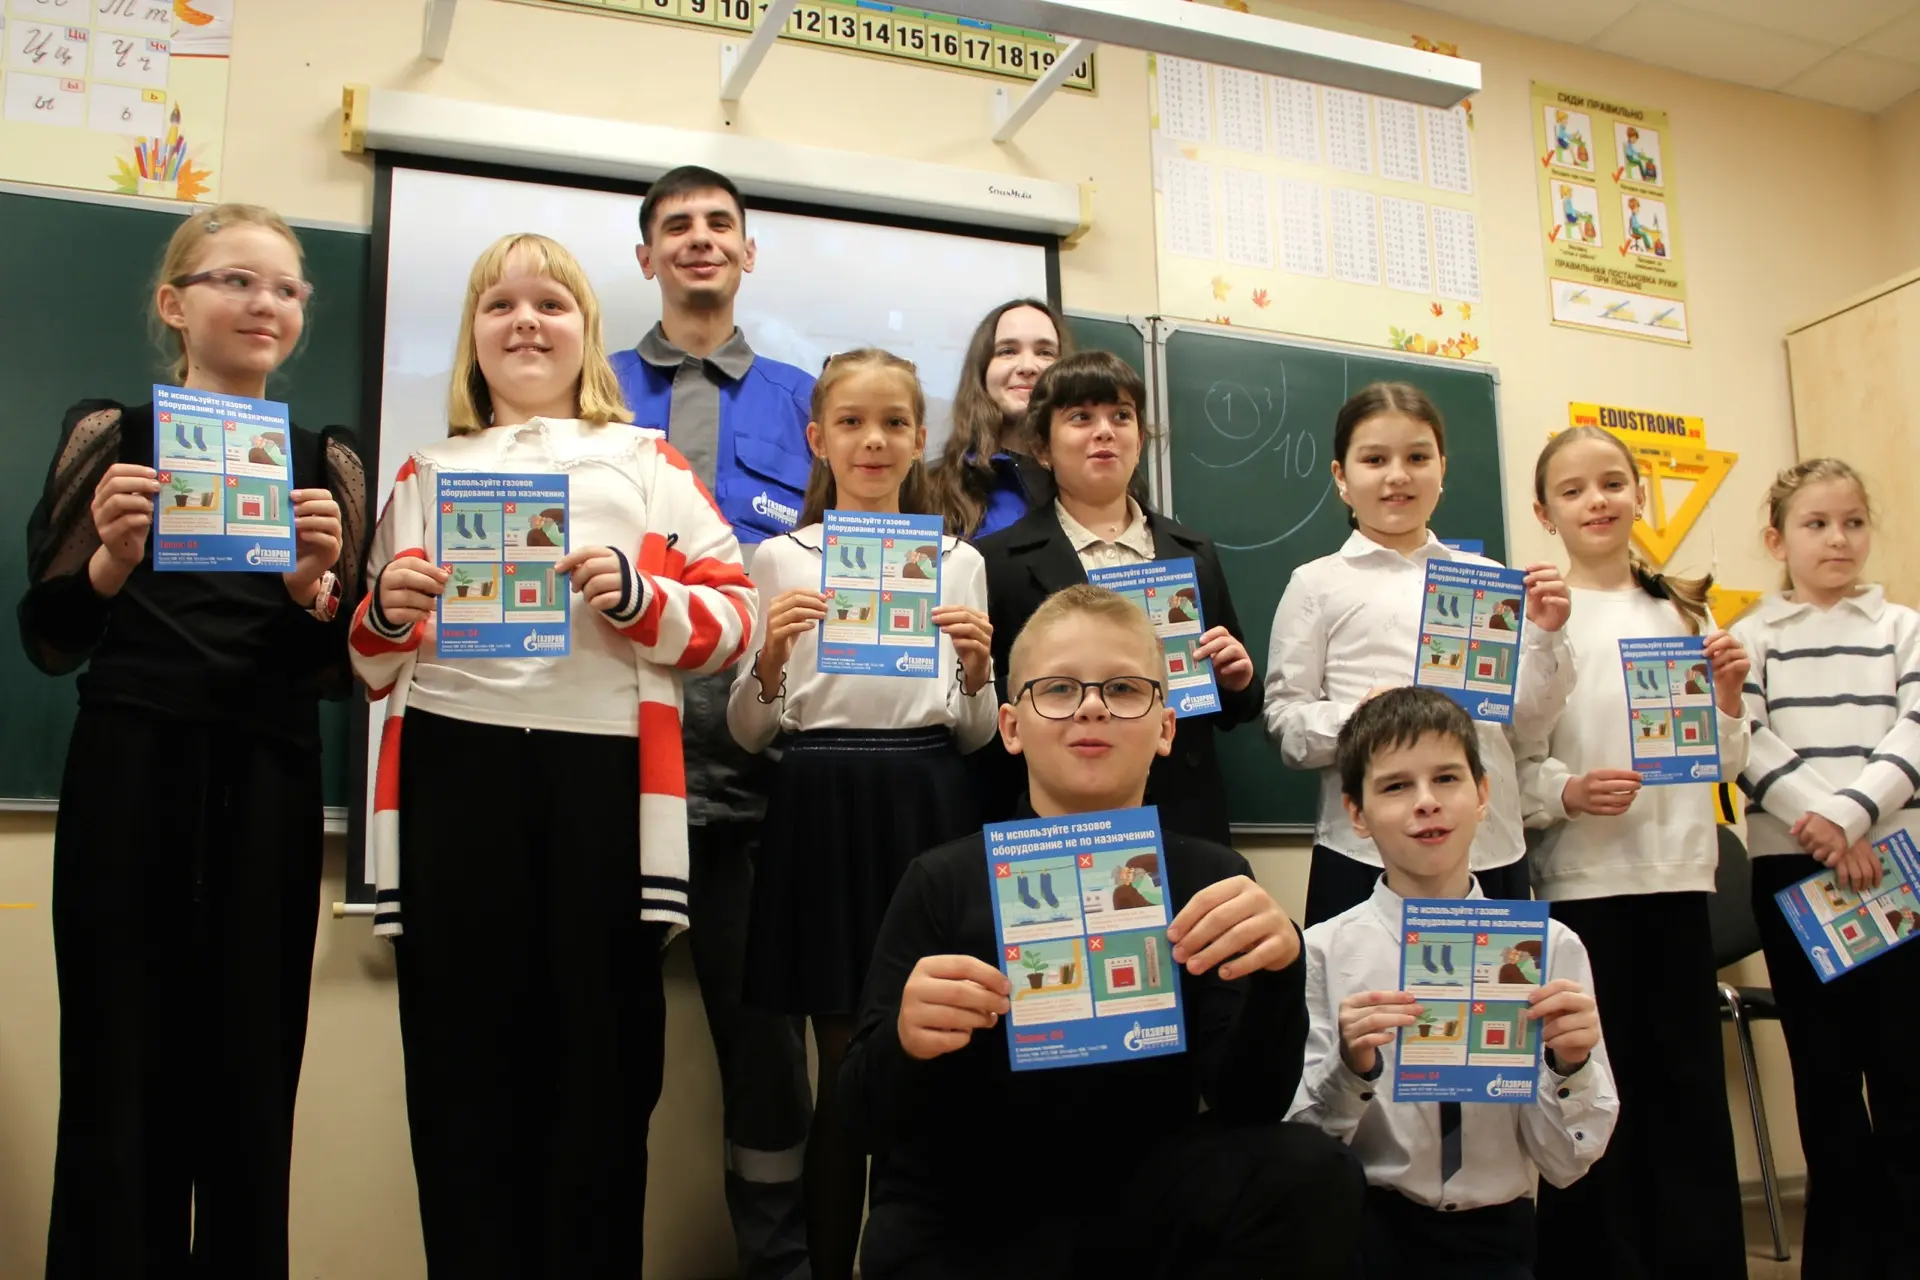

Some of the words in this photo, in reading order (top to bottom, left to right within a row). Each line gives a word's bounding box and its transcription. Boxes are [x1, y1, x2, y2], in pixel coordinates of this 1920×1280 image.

[723, 0, 749, 20] 10
[793, 9, 821, 33] 12
[828, 14, 856, 38] 13
[862, 20, 890, 44] 14
[897, 26, 924, 50] 15
[931, 32, 958, 56] 16
[964, 38, 991, 62] 17
[997, 44, 1024, 68] 18
[1557, 92, 1585, 108] СИДИ
[1586, 98, 1644, 120] ПРАВИЛЬНО
[1555, 260, 1605, 275] ПРАВИЛЬНАЯ
[1608, 269, 1656, 285] ПОСТАНОВКА
[158, 390, 168, 398] Не
[171, 393, 220, 406] используйте
[221, 400, 252, 411] газовое
[1222, 392, 1232, 421] 1
[159, 400, 214, 414] оборудование
[238, 411, 284, 424] назначению
[1599, 407, 1686, 436] EDUSTRONG
[1273, 429, 1316, 479] 10
[453, 478, 501, 488] используйте
[441, 489, 494, 498] оборудование
[519, 490, 565, 498] назначению
[768, 499, 798, 518] ГАЗПРОМ
[839, 516, 881, 525] используйте
[828, 524, 875, 533] оборудование
[261, 549, 290, 558] ГАЗПРОМ
[1102, 569, 1140, 580] используйте
[1142, 566, 1166, 575] газовое
[1156, 572, 1193, 581] назначению
[1439, 566, 1475, 575] используйте
[1476, 570, 1500, 578] газовое
[1428, 573, 1470, 584] оборудование
[1487, 580, 1523, 590] назначению
[537, 635, 565, 643] ГАЗПРОМ
[909, 657, 934, 665] ГАЗПРОМ
[991, 831, 1003, 842] Не
[1006, 824, 1069, 840] используйте
[1072, 820, 1112, 832] газовое
[992, 840, 1063, 856] оборудование
[1066, 839, 1077, 847] не
[1080, 837, 1091, 846] по
[1094, 829, 1155, 845] назначению
[1141, 1024, 1178, 1038] ГАЗПРОМ
[1502, 1080, 1532, 1088] ГАЗПРОМ
